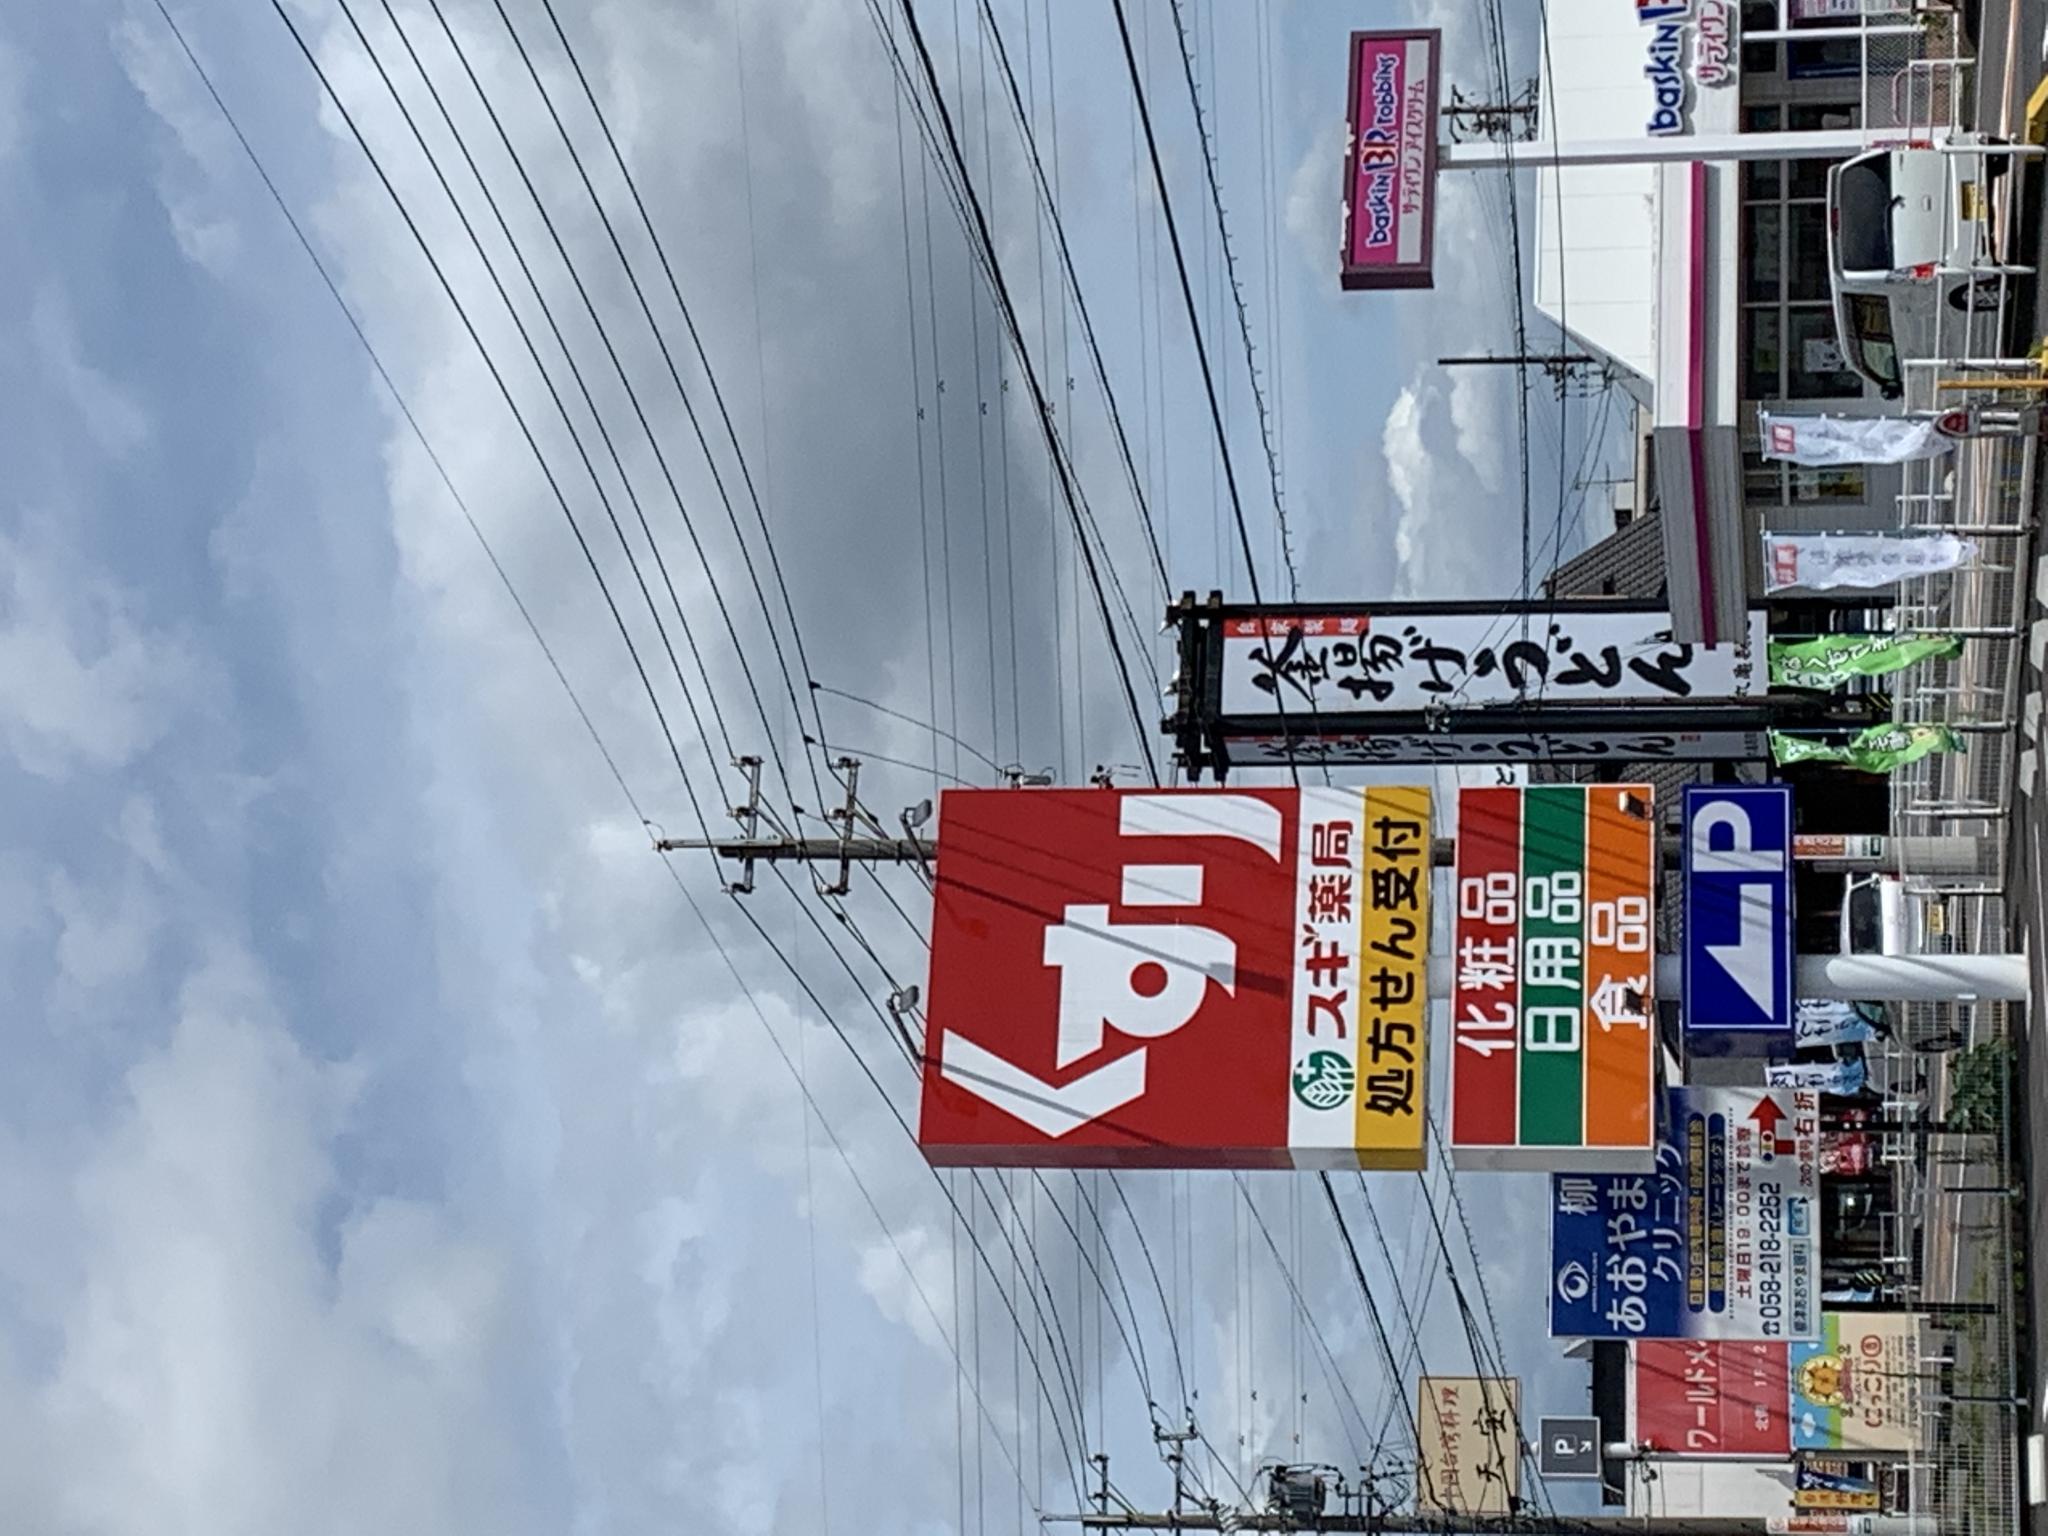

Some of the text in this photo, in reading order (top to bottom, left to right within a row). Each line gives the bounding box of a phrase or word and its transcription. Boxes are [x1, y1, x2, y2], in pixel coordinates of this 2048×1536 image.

[1403, 80, 1425, 214] サーティワン アイスクリーム
[1644, 24, 1680, 131] baskin
[1363, 55, 1397, 245] baskin BR robbins
[1248, 626, 1692, 701] 釜揚げうどん
[1692, 801, 1783, 872] P
[941, 795, 1281, 1137] くすり
[1302, 821, 1354, 1039] スギ薬局
[1365, 816, 1421, 1116] 処方せん受付
[1457, 872, 1516, 1057] 化粧品
[1524, 871, 1581, 1051] 日用品
[1589, 897, 1648, 1031] 食品
[1605, 1177, 1647, 1332] あおやま
[1653, 1141, 1682, 1282] クリニック
[1759, 1182, 1781, 1318] 058-218-2252
[1555, 1439, 1574, 1454] P
